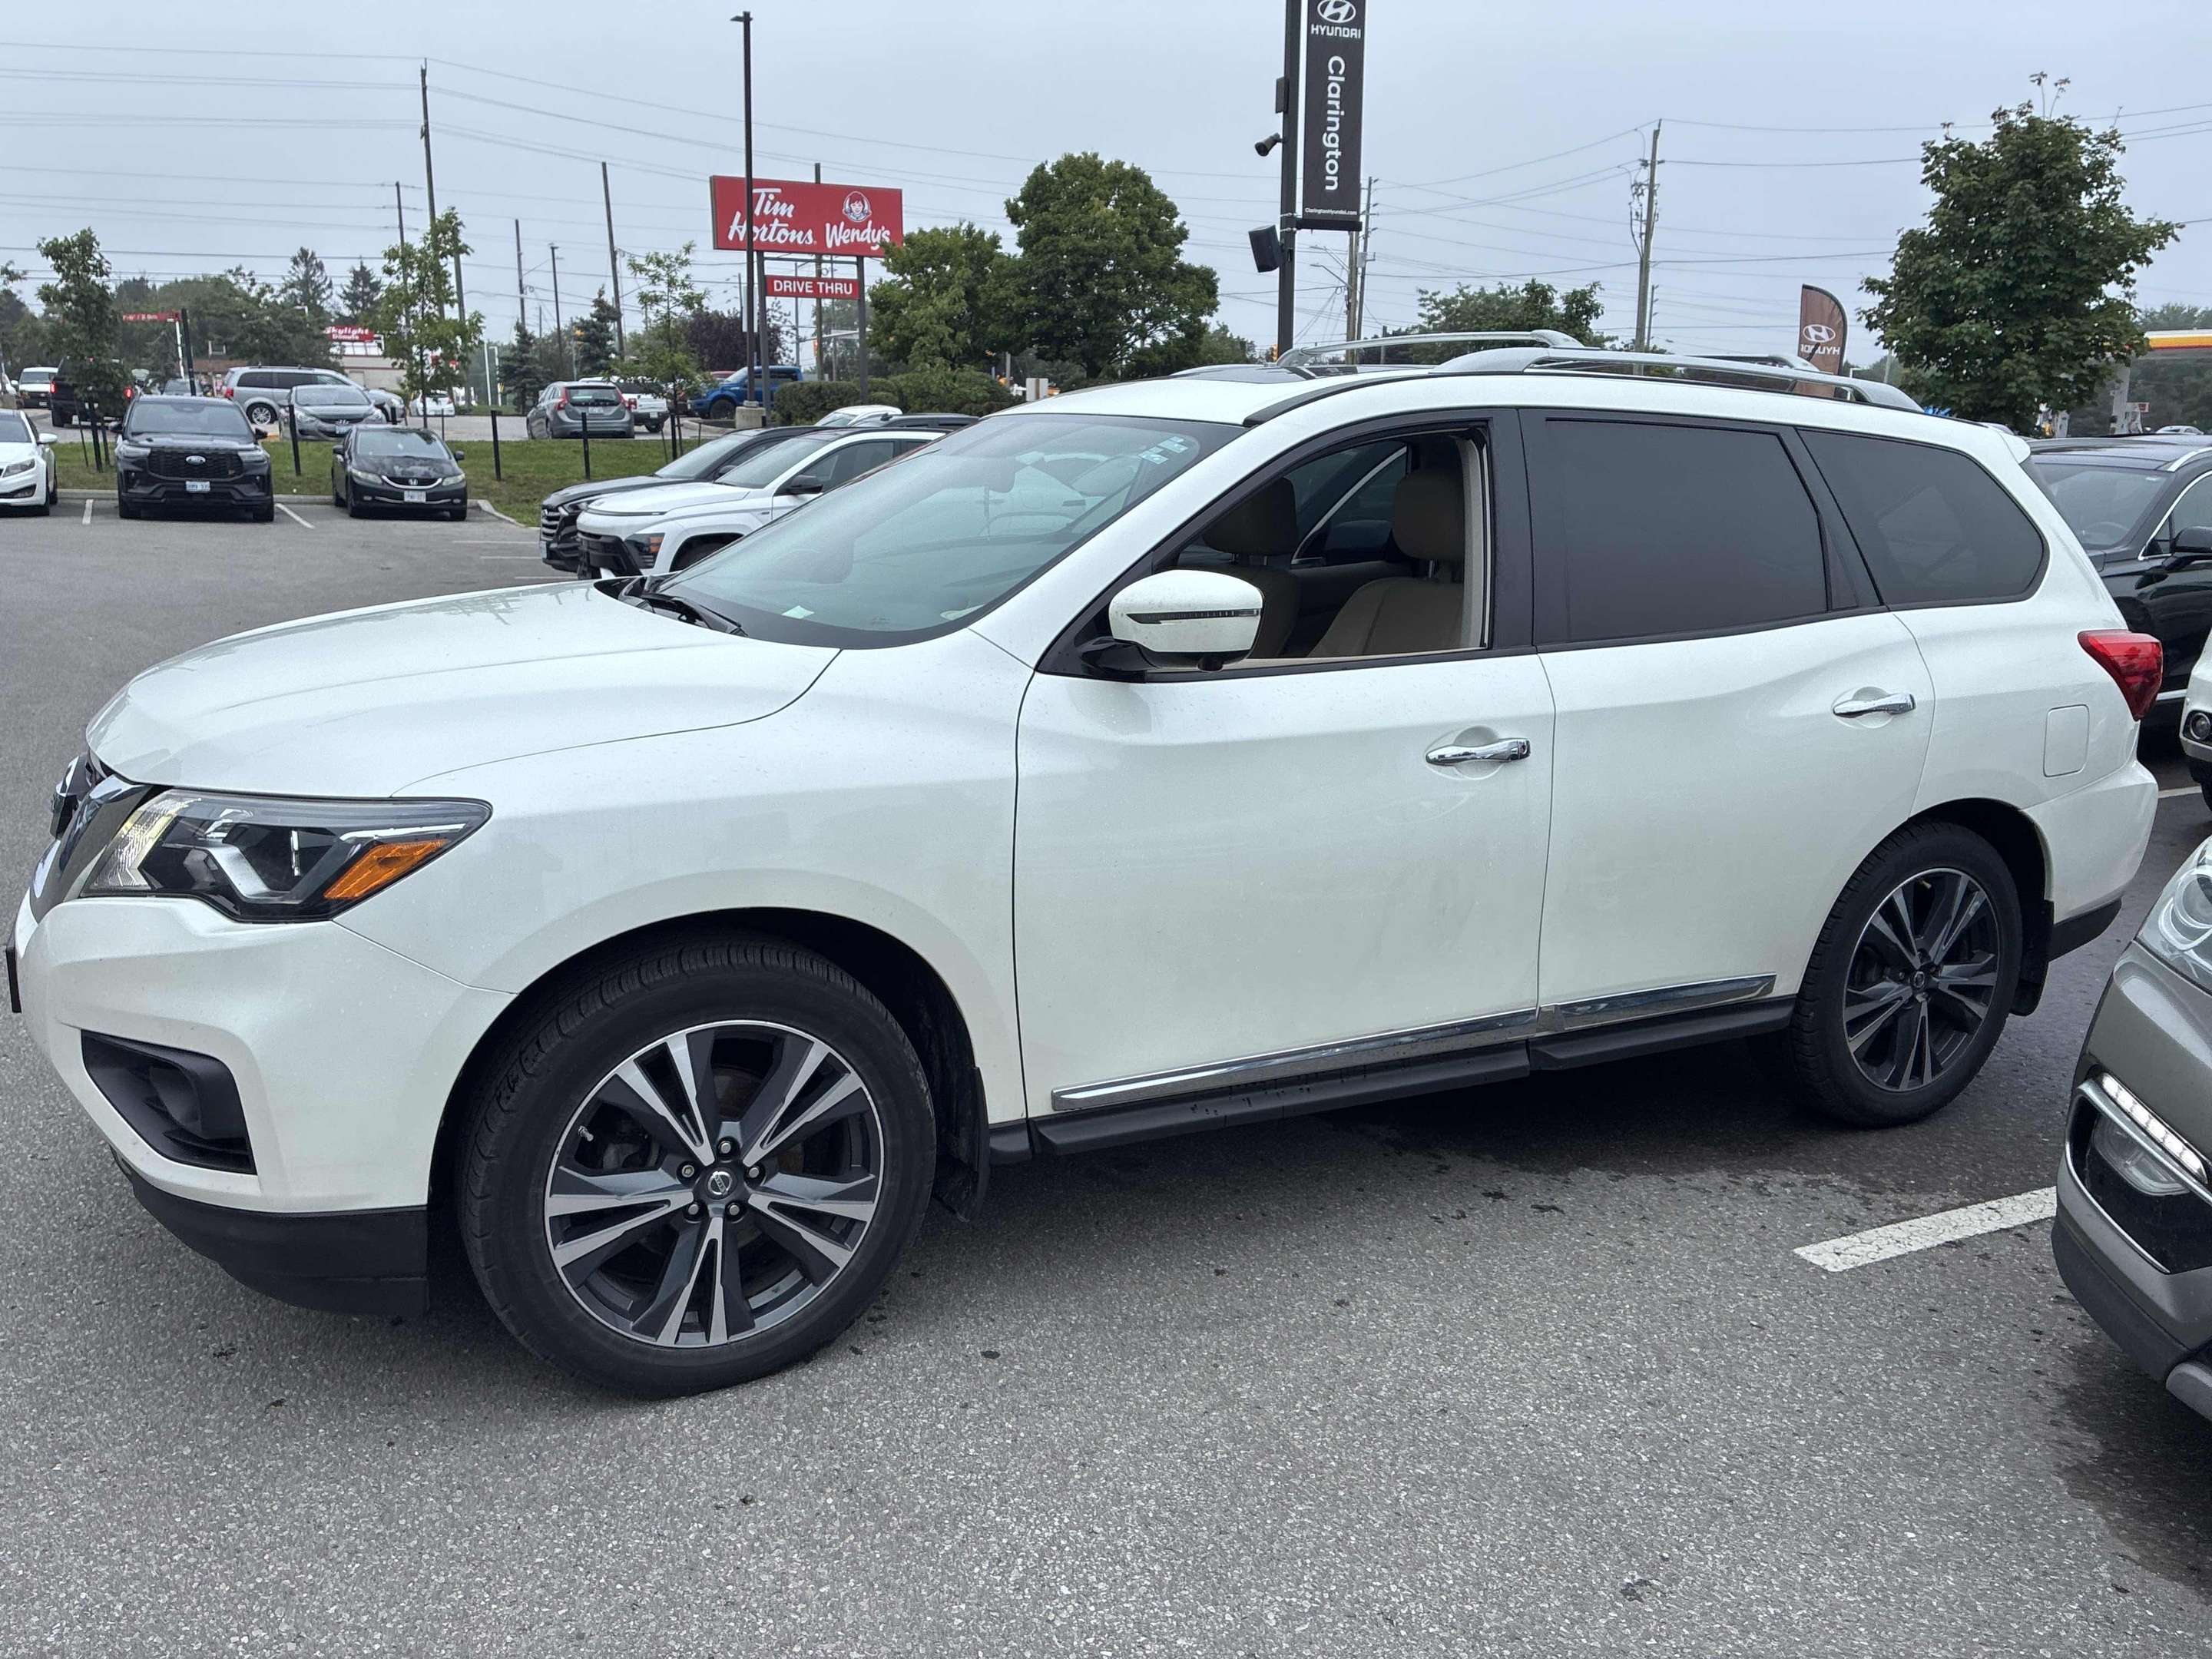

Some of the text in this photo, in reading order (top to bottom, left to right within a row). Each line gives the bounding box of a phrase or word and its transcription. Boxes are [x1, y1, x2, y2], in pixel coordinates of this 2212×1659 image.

[1310, 24, 1361, 39] HYUNDAI
[1322, 55, 1346, 190] Clarington
[752, 187, 795, 218] Tim
[825, 220, 891, 250] Wendy's
[773, 279, 853, 295] DRIVE THRU
